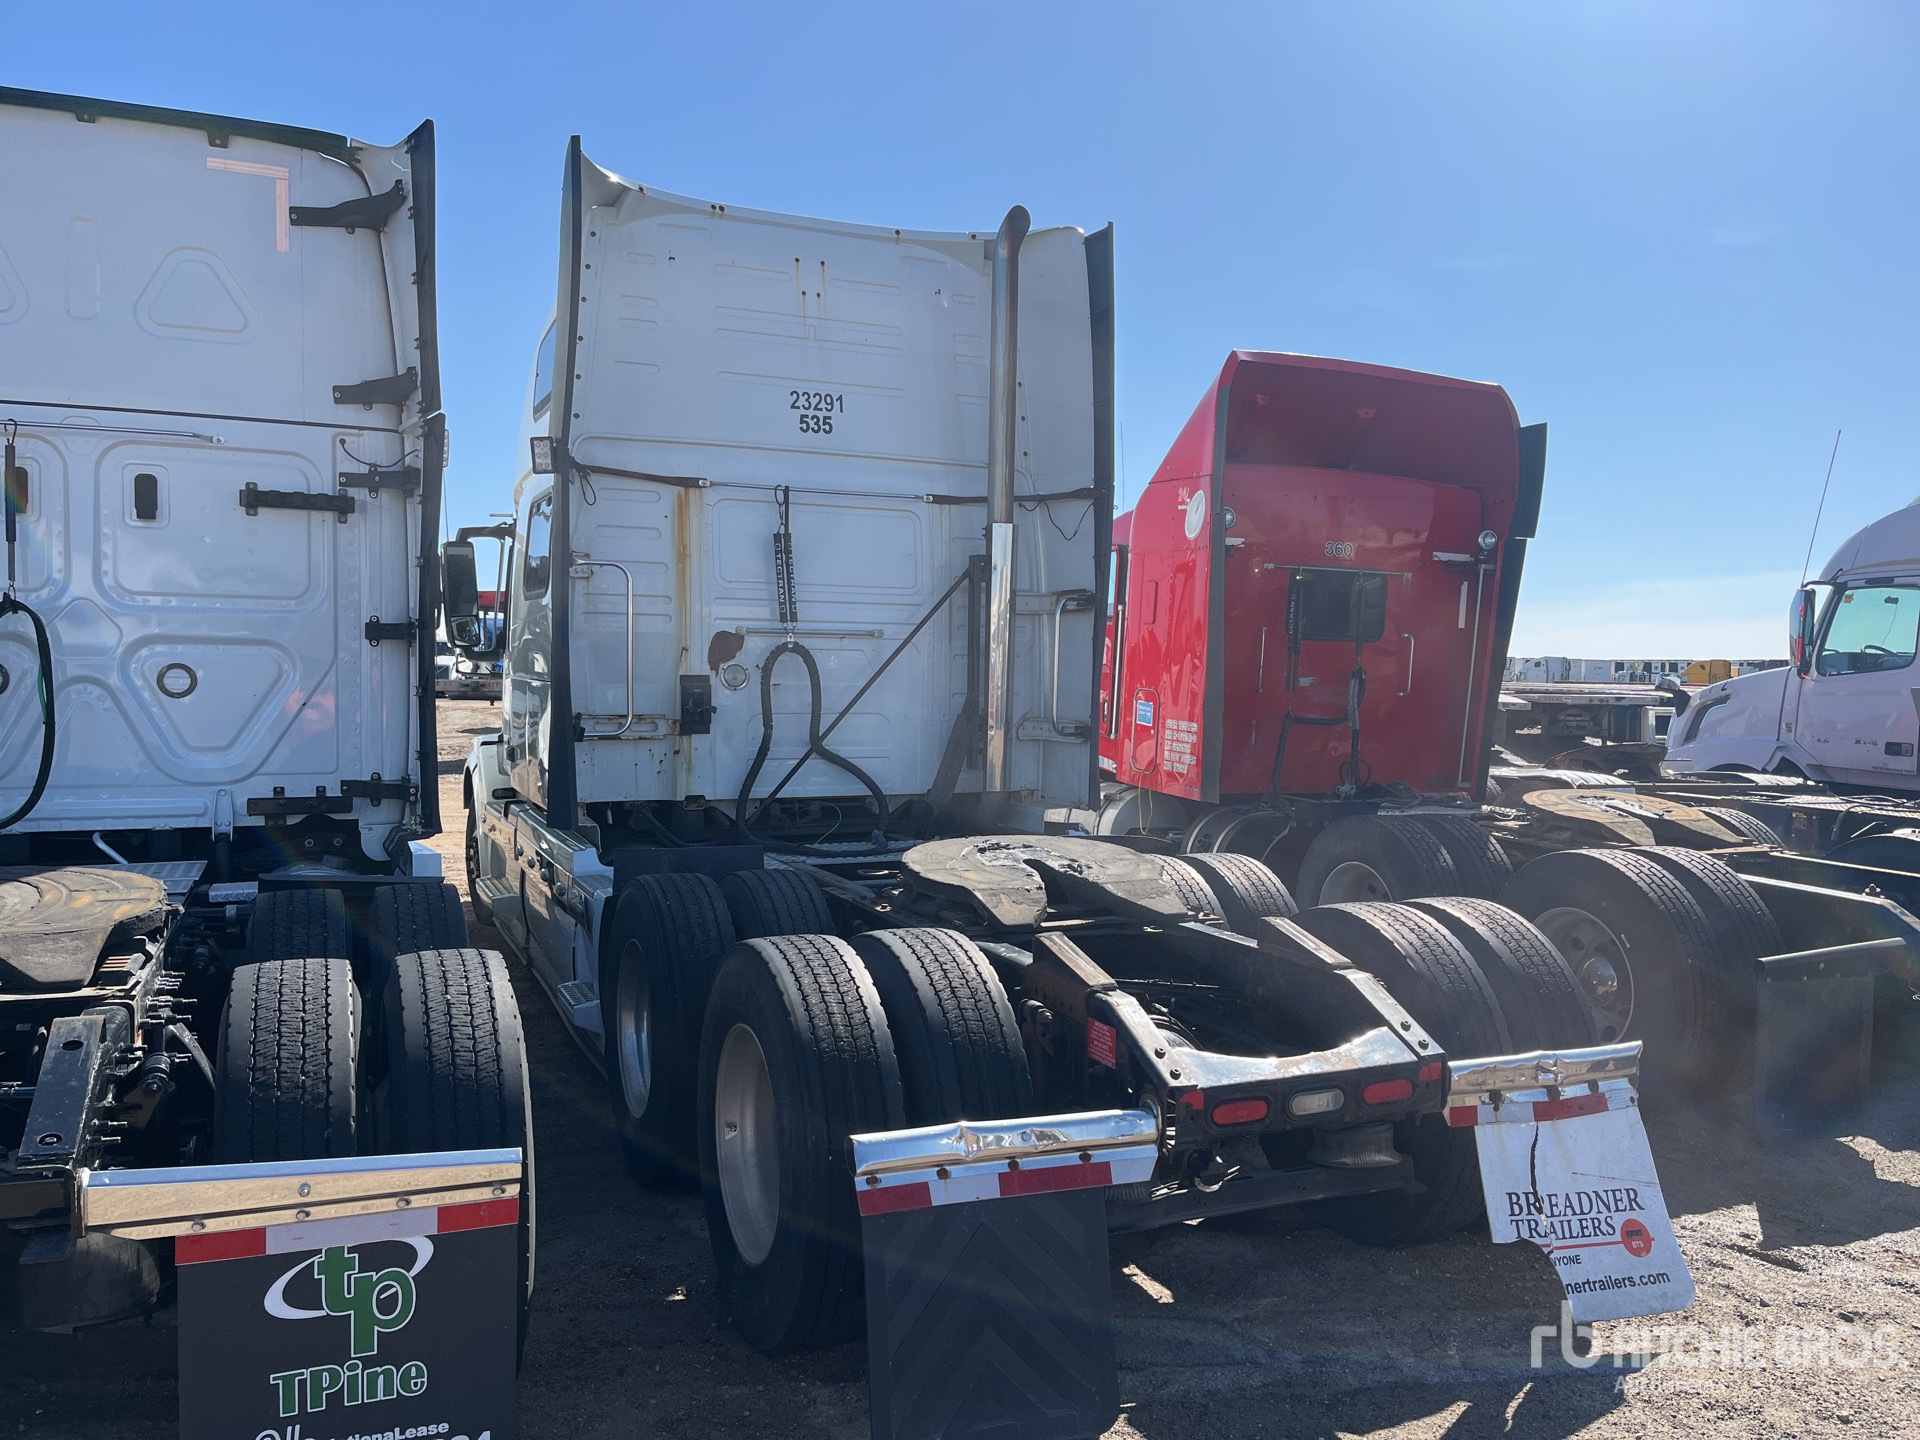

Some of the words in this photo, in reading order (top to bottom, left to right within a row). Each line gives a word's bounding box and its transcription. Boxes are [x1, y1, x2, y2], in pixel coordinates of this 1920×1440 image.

[789, 390, 844, 413] 23291
[799, 414, 833, 434] 535
[1325, 541, 1353, 558] 360
[775, 553, 785, 602] TECTRAN
[1505, 1187, 1645, 1218] BREADNER
[1510, 1215, 1616, 1240] TRAILERS
[270, 1360, 428, 1417] TPine
